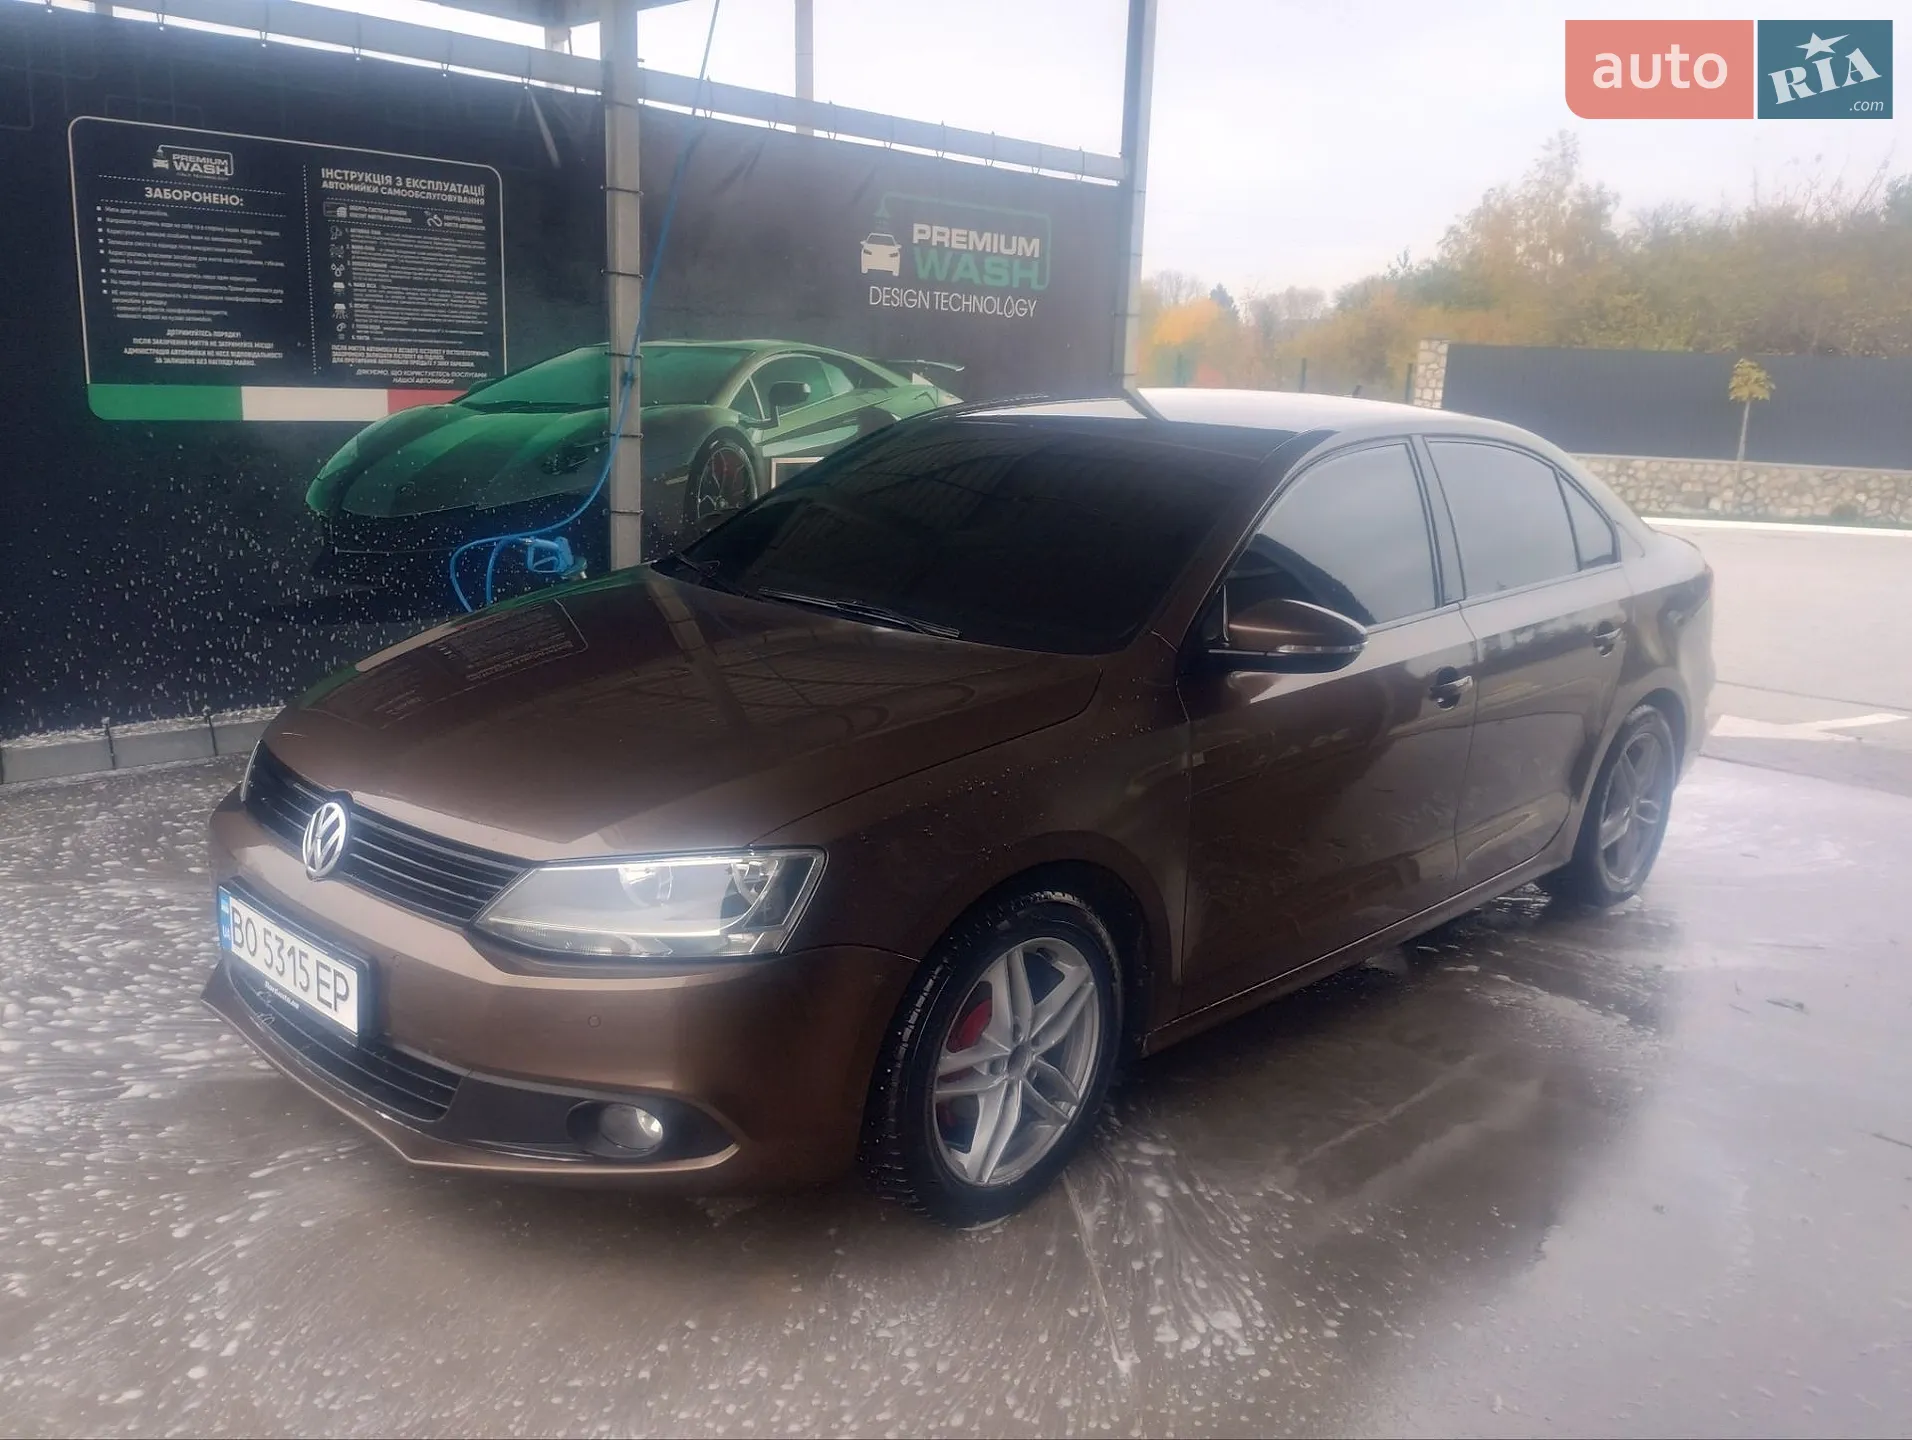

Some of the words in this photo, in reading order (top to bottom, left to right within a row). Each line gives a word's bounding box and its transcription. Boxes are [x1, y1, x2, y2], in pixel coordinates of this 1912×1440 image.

[172, 153, 229, 166] PREMIUM
[173, 160, 229, 175] WASH
[144, 187, 244, 207] ЗАБОРОНЕНО:
[321, 167, 392, 186] ІНСТРУКЦІЯ
[405, 177, 485, 197] ЕКСПЛУАТАЦІЇ
[321, 180, 379, 194] АВТОМИЙКИ
[380, 187, 485, 206] САМООБСЛУГОВУВАННЯ
[912, 223, 1040, 258] PREMIUM
[914, 247, 1043, 289] WASH
[869, 286, 930, 310] DESIGN
[933, 291, 1037, 318] TECHNOLOGY
[231, 906, 258, 957] BO
[263, 927, 310, 993] 5315
[316, 959, 349, 1012] EP
